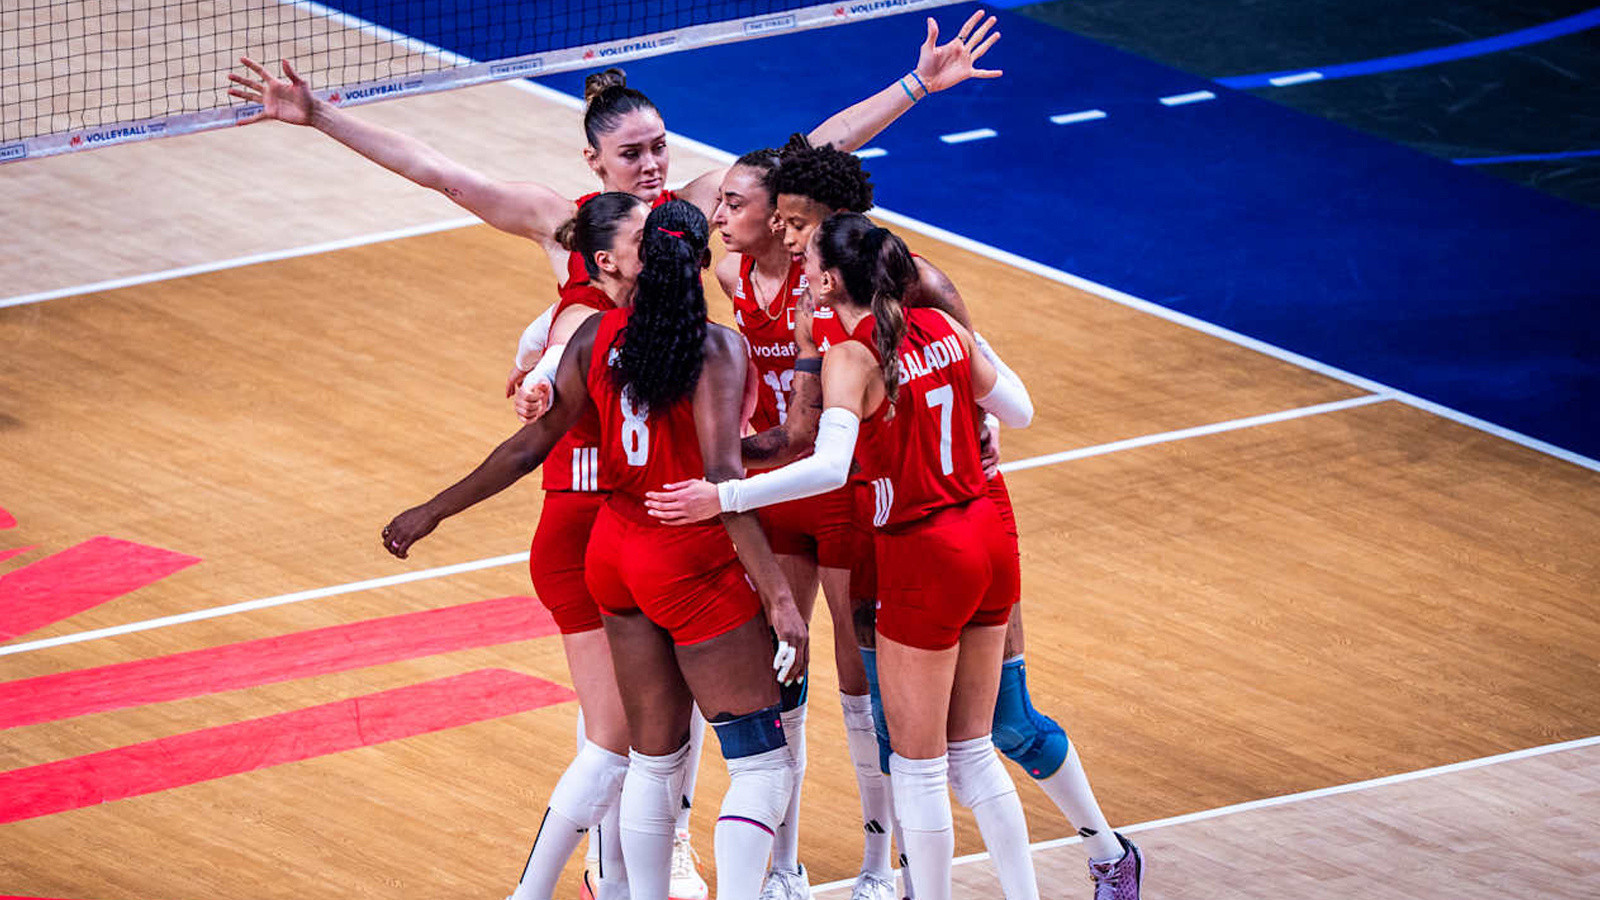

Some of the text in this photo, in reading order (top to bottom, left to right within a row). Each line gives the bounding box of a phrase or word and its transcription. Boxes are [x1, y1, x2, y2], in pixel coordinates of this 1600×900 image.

[599, 40, 657, 57] VOLLEYBALL
[345, 84, 403, 100] VOLLEYBALL
[86, 125, 146, 143] VOLLEYBALL
[753, 342, 798, 358] vodaf
[621, 382, 649, 466] 8
[925, 384, 954, 476] 7
